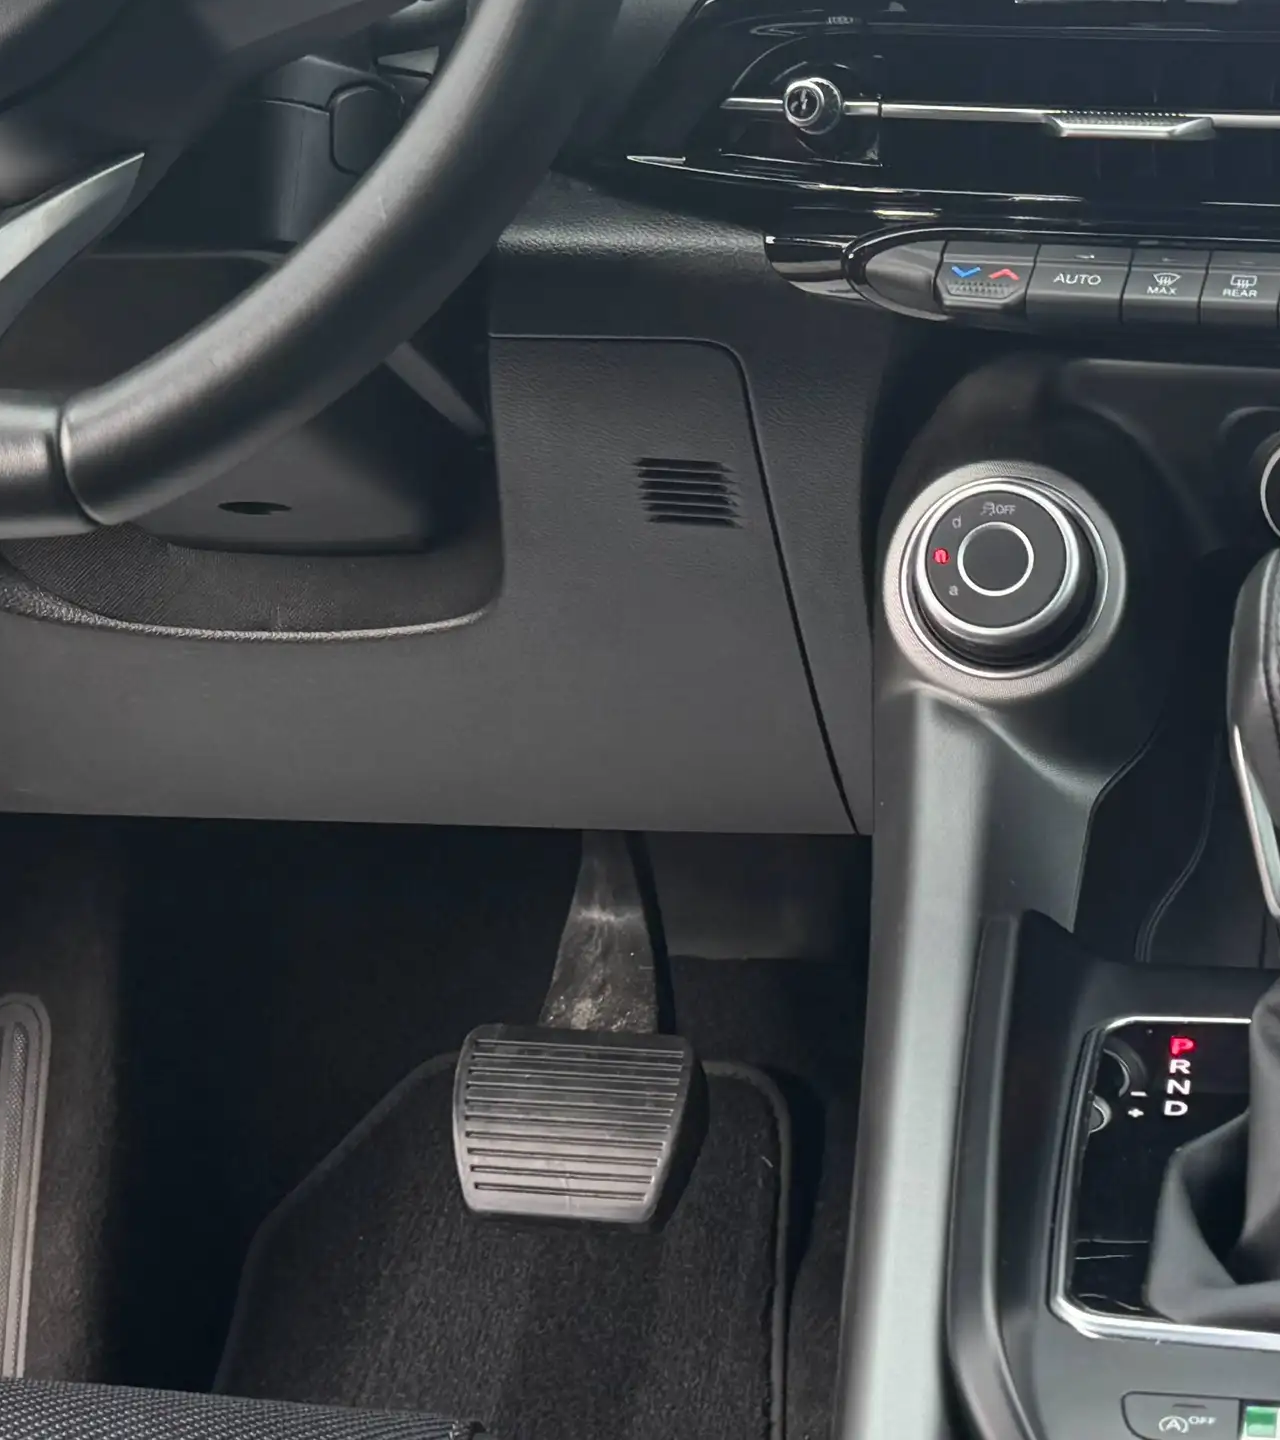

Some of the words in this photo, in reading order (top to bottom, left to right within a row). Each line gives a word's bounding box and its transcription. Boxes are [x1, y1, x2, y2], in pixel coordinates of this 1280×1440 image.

[1053, 272, 1102, 287] AUTO
[1147, 284, 1178, 296] MAX
[1223, 287, 1258, 299] REAR
[995, 504, 1016, 515] OFF
[1171, 1036, 1195, 1056] P
[1170, 1059, 1191, 1074] R
[1167, 1079, 1191, 1095] N
[1164, 1100, 1188, 1116] D
[1189, 1417, 1217, 1426] OFF
